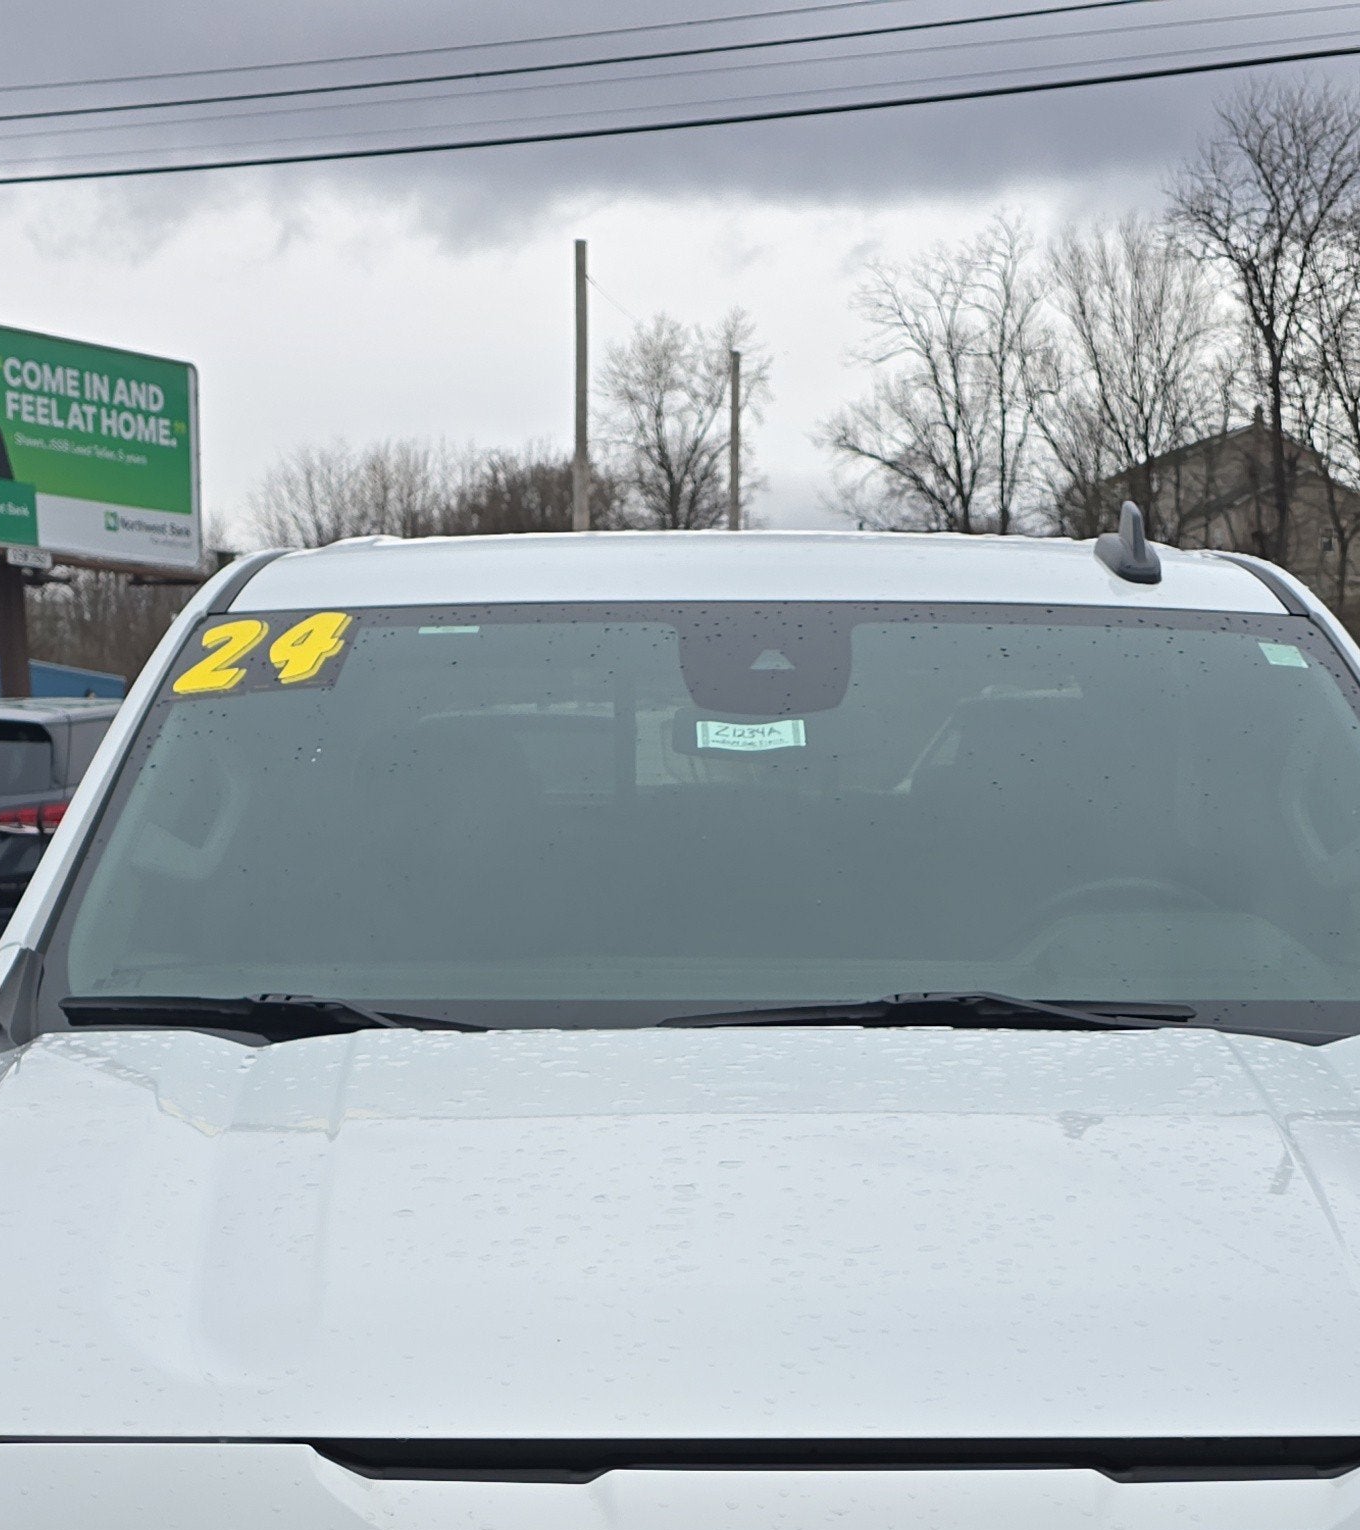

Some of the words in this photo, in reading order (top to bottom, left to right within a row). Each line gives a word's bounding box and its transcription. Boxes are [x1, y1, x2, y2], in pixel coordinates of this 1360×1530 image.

[5, 390, 64, 428] FEEL
[67, 402, 97, 434] AT
[84, 370, 110, 403] IN
[113, 377, 165, 412] AND
[173, 612, 353, 694] 24
